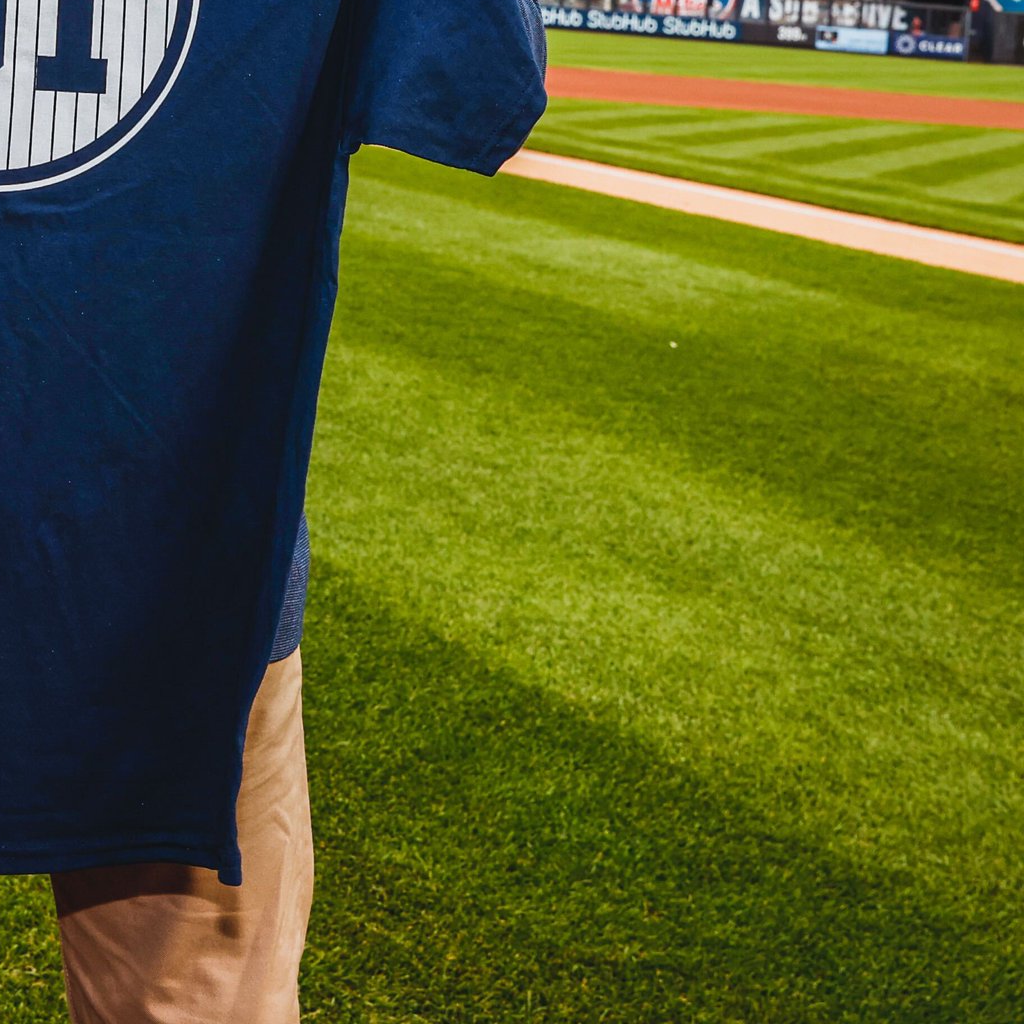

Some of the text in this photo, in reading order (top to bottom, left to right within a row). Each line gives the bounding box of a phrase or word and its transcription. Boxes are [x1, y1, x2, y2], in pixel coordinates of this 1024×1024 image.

[542, 7, 736, 41] bHub StubHub StubHub
[918, 39, 963, 54] CLEAR
